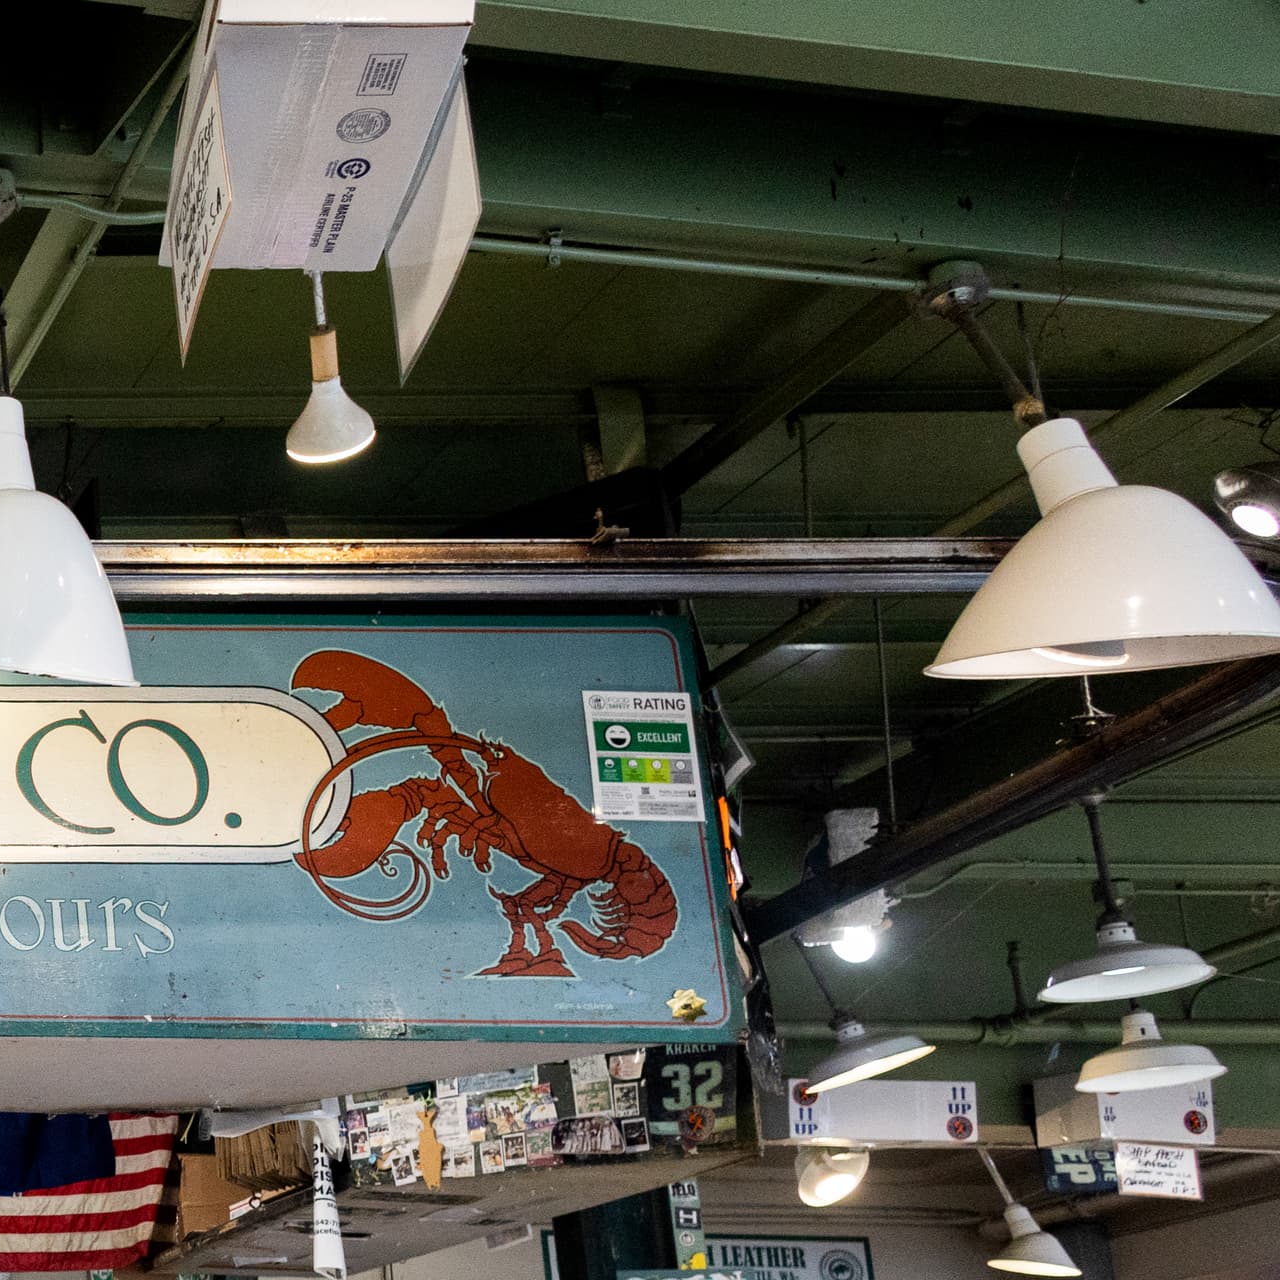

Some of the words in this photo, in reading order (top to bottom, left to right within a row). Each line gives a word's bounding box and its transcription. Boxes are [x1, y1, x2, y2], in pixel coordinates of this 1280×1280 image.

[341, 186, 356, 203] P-25
[319, 193, 336, 217] AIRLINE
[330, 203, 350, 233] MASTER
[322, 233, 340, 253] PLAIN
[633, 698, 686, 711] RATING
[637, 732, 682, 744] EXCELLENT
[16, 709, 243, 835] CO.
[661, 1061, 723, 1111] 32
[948, 1103, 972, 1115] UP
[795, 1123, 819, 1135] UP
[721, 1245, 806, 1269] LEATHER
